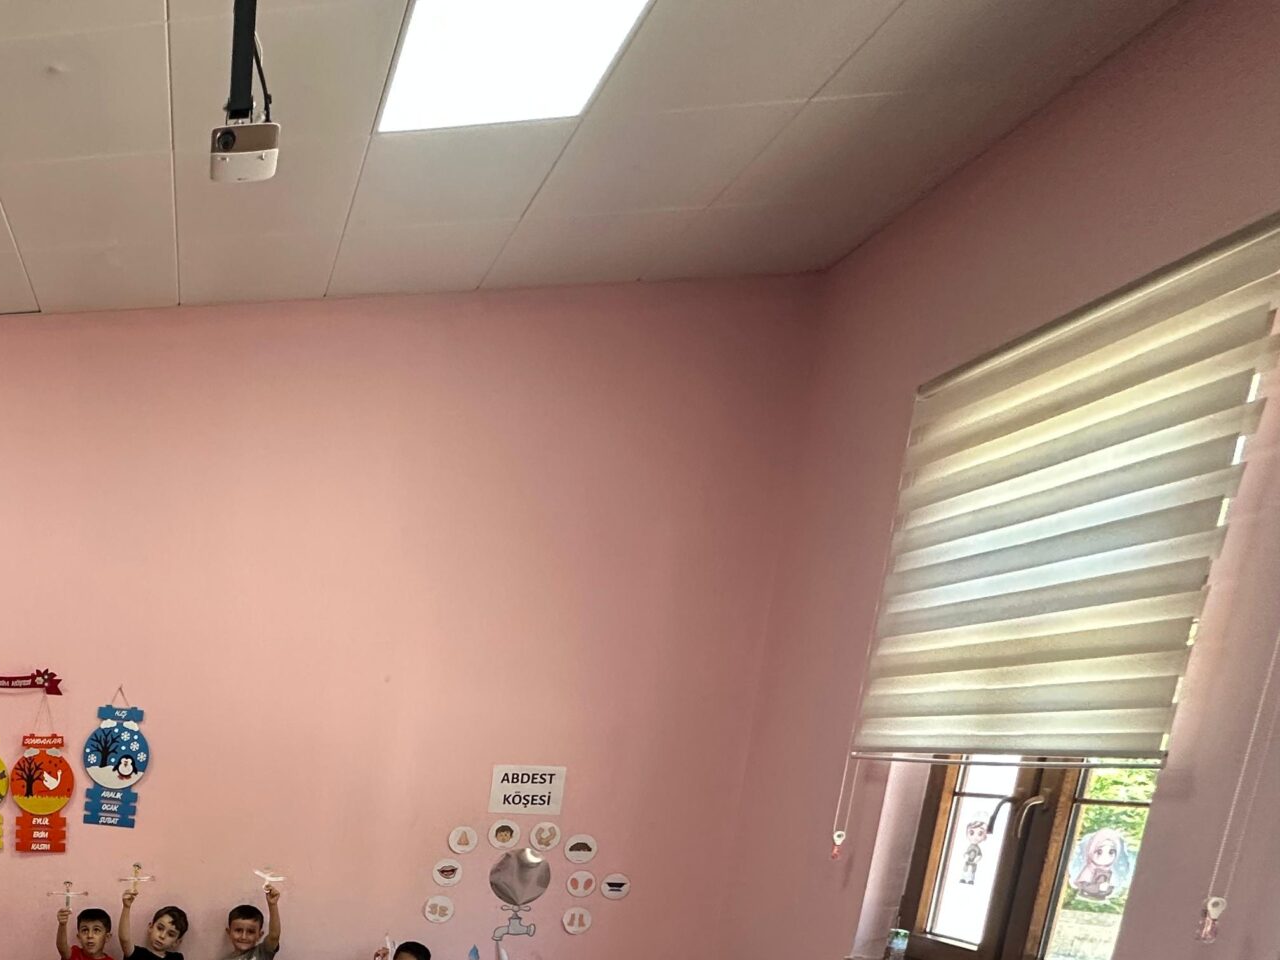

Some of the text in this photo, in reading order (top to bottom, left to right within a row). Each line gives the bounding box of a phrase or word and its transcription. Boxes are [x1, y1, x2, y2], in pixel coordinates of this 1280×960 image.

[500, 771, 556, 785] ABDEST
[502, 791, 552, 808] KÖŞESİ
[101, 803, 119, 812] OCAK
